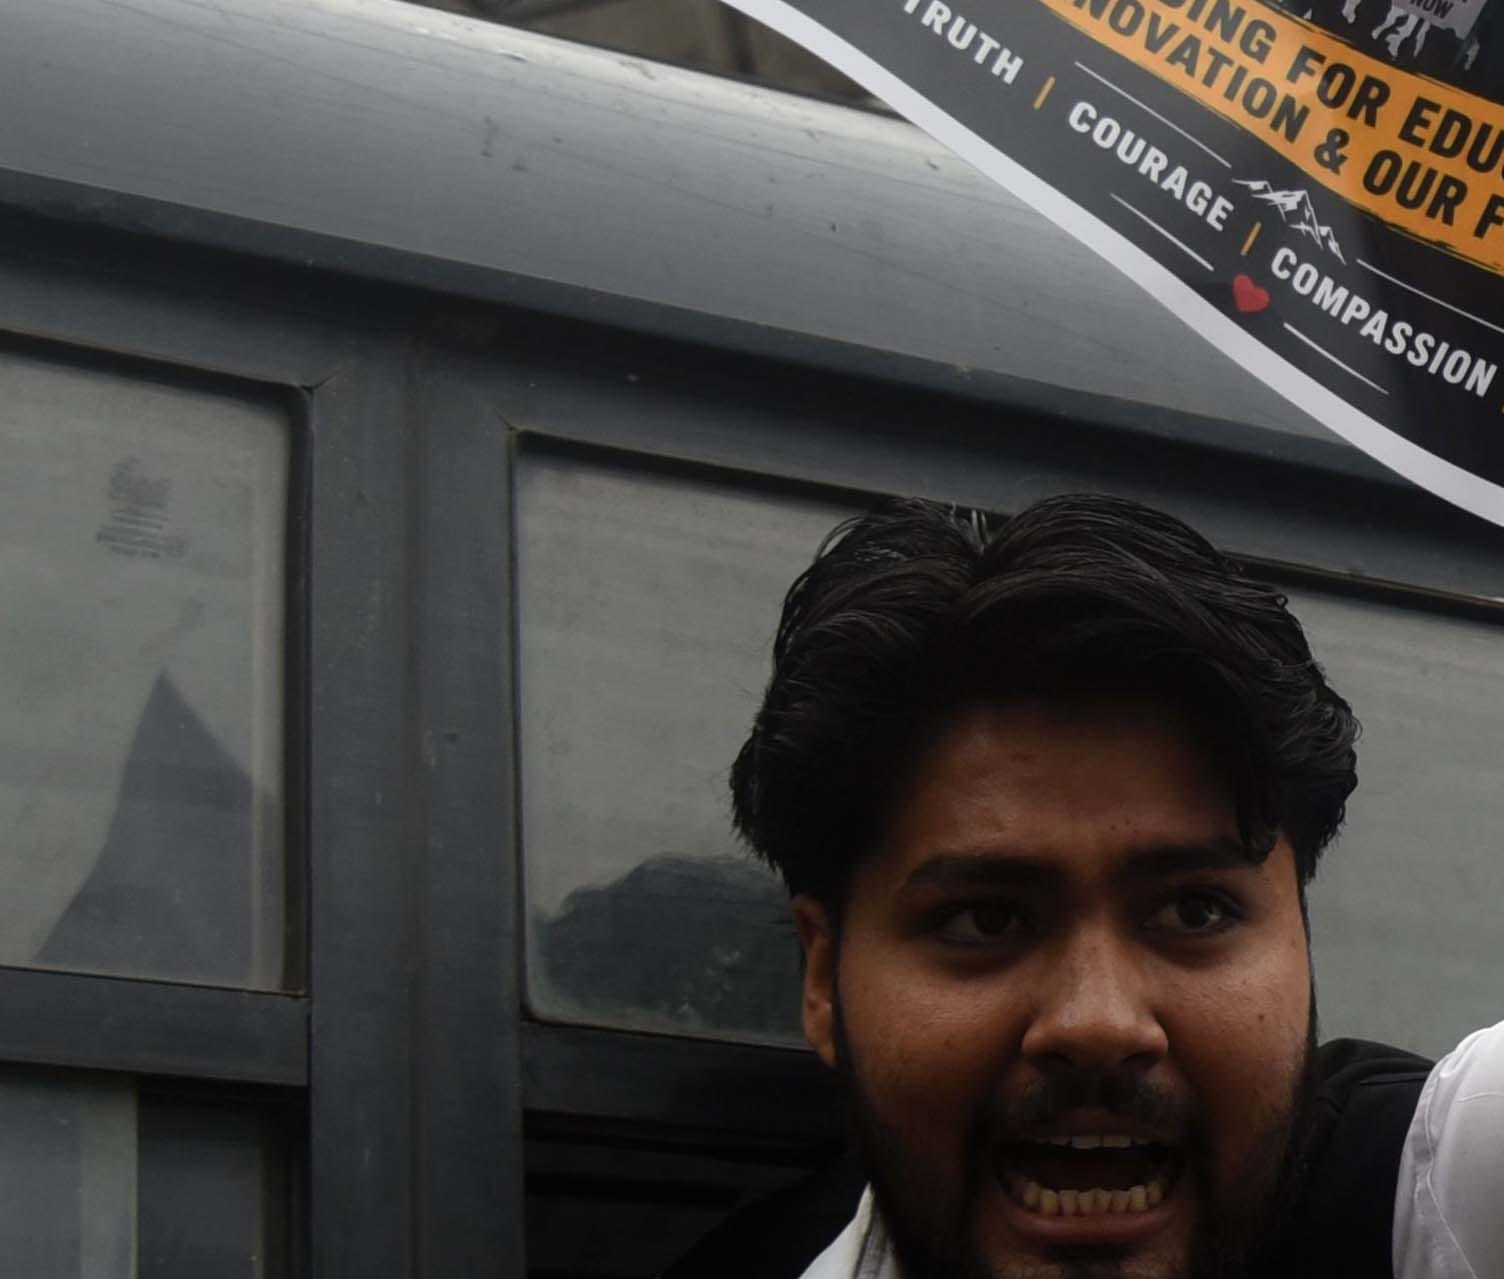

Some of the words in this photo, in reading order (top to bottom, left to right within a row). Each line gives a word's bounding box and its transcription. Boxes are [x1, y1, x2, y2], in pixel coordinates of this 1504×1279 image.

[1286, 51, 1391, 127] FOR
[1313, 127, 1350, 175] &
[1362, 149, 1468, 226] OUR
[1068, 100, 1236, 232] COURAGE
[1270, 247, 1498, 398] COMPASSION
